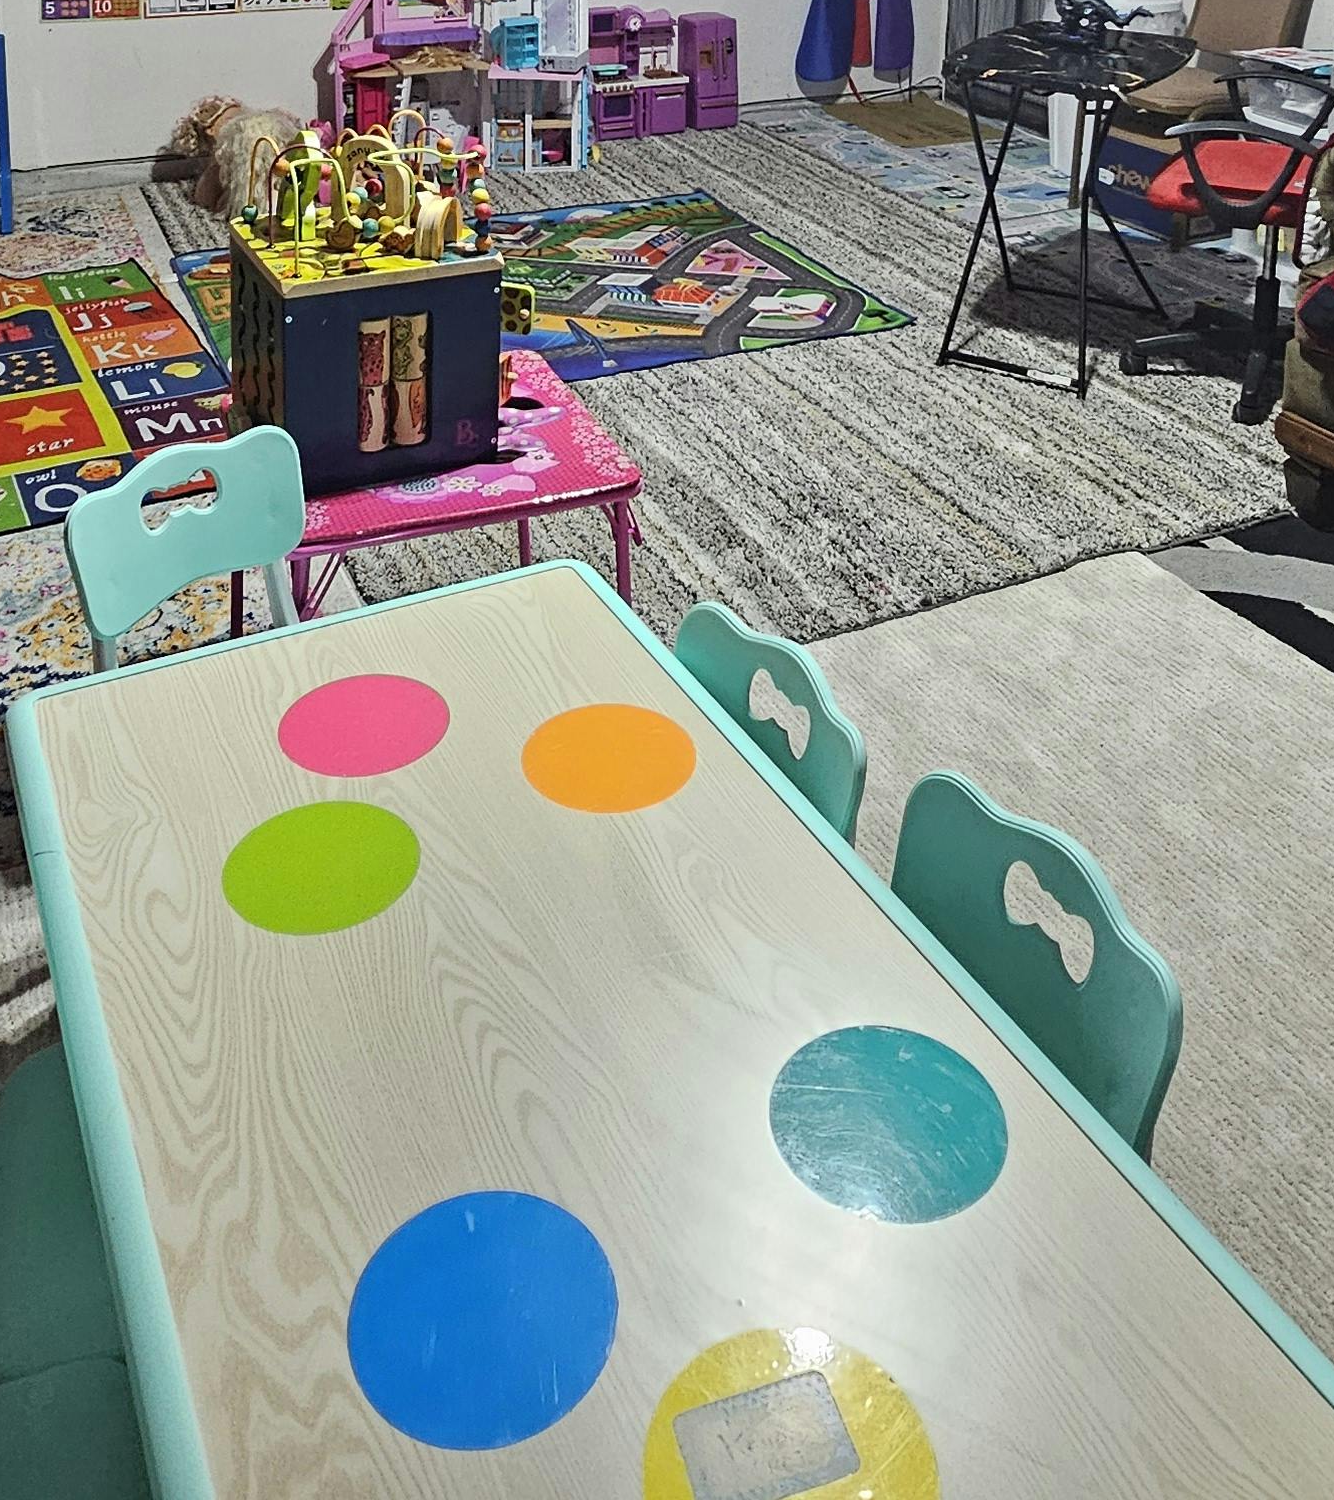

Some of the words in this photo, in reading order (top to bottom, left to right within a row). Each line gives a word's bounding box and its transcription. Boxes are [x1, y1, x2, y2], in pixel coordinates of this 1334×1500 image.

[95, 0, 111, 13] 10
[347, 147, 370, 161] zany
[66, 298, 130, 314] jellyfish
[91, 342, 159, 364] Kk
[97, 362, 158, 378] lemon
[123, 401, 179, 415] mouse
[26, 437, 75, 456] star
[25, 470, 57, 484] owl
